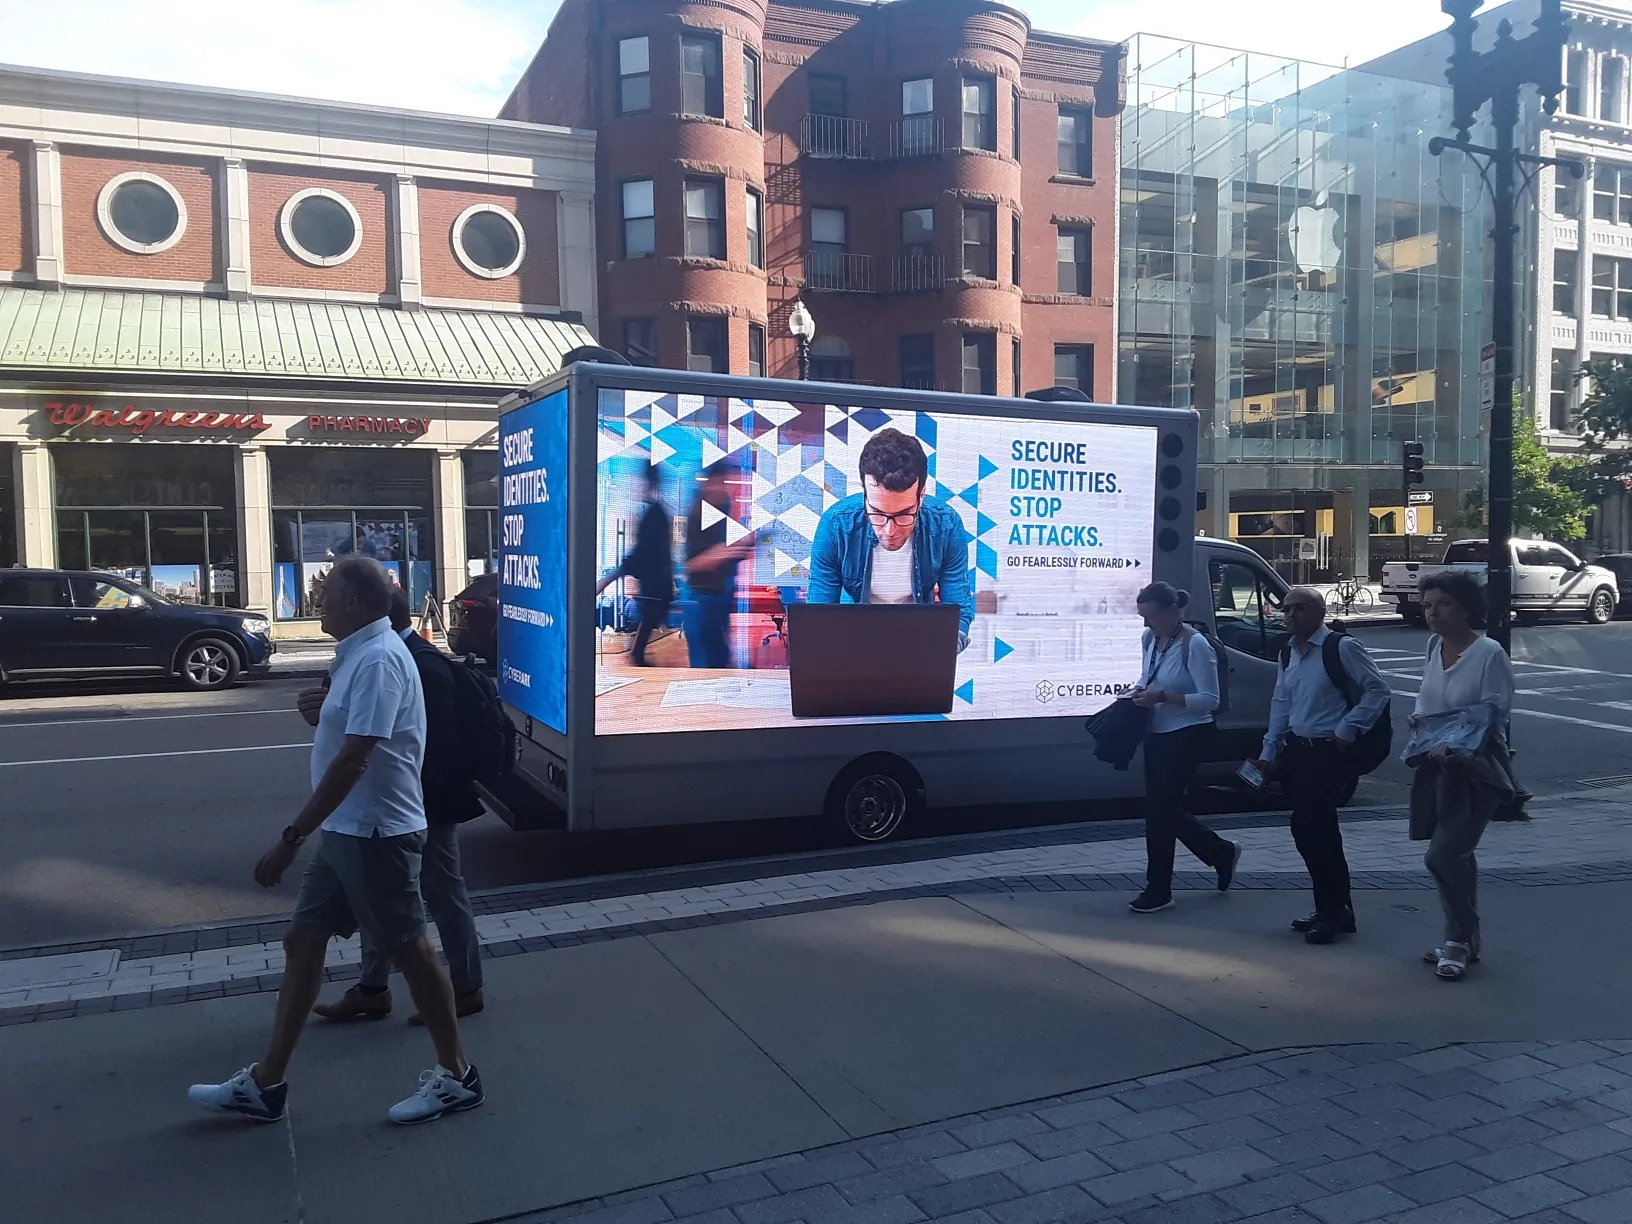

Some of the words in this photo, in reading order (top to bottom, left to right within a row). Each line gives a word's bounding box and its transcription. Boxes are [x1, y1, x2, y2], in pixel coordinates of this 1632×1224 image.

[44, 403, 272, 434] Walgreens
[308, 415, 432, 434] PHARMACY
[503, 428, 534, 467] SECURE
[1011, 440, 1087, 464] SECURE
[503, 468, 550, 507] IDENTITIES.
[1010, 468, 1122, 493] IDENTITIES.
[1009, 496, 1062, 518] STOP
[503, 515, 525, 547] STOP
[1008, 524, 1103, 547] ATTACKS.
[503, 554, 541, 589] ATTACKS.
[1007, 556, 1020, 567] GO
[1022, 556, 1078, 568] FEARLESSLY
[1080, 557, 1124, 568] FORWARD
[508, 666, 531, 688] CYBERARK
